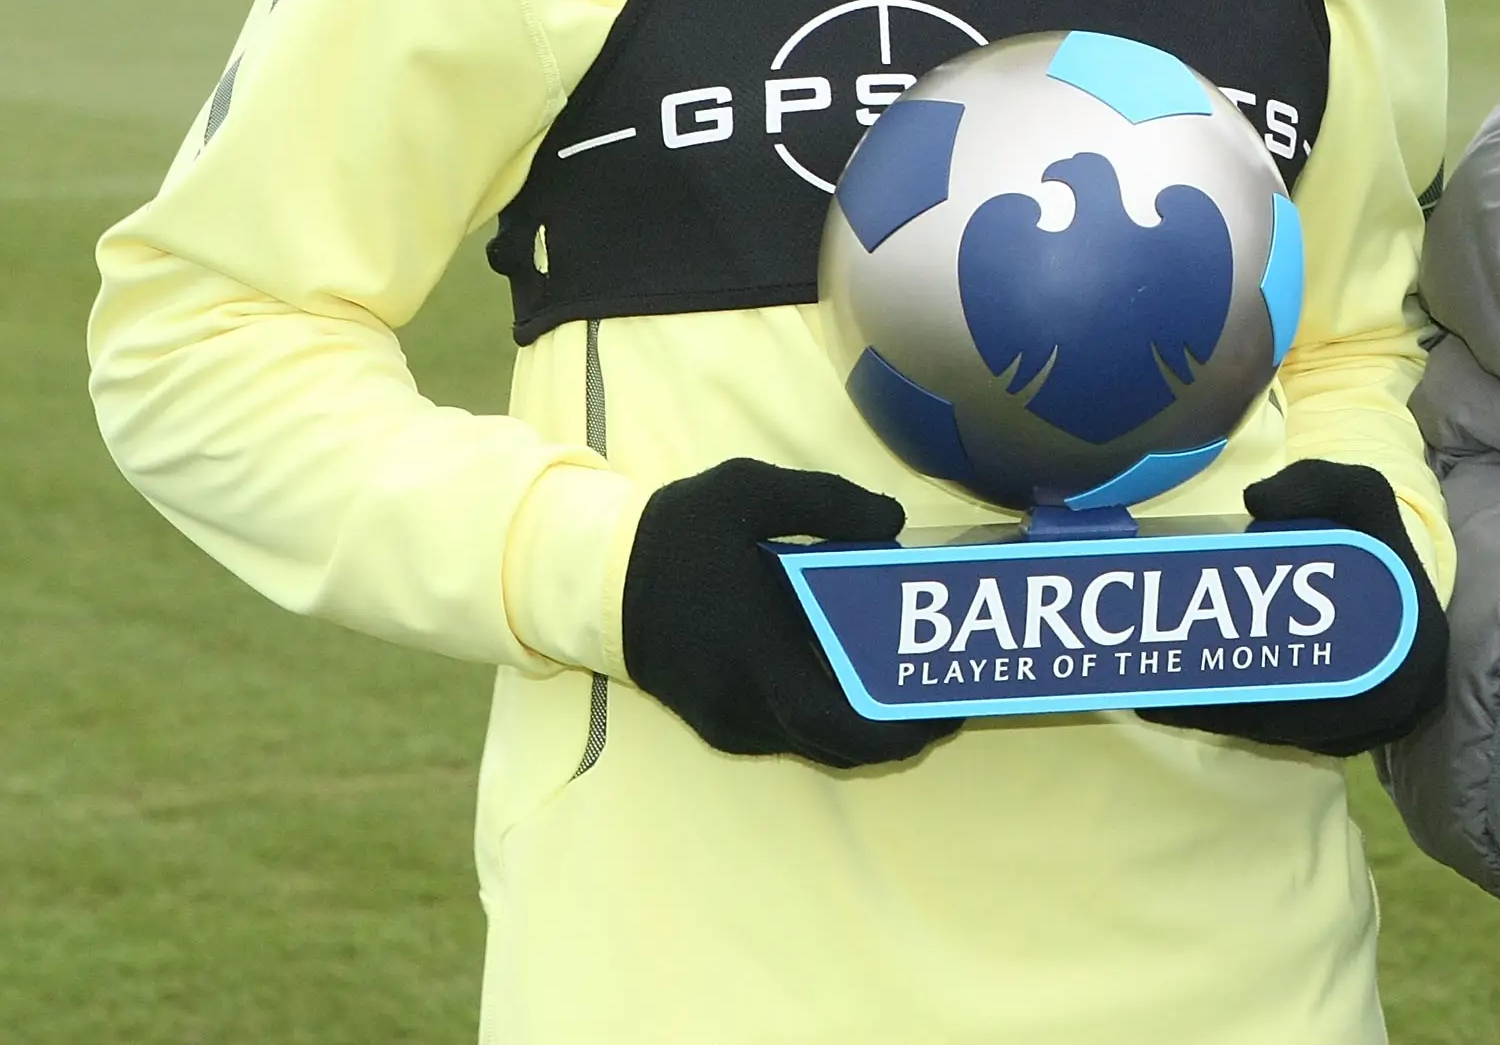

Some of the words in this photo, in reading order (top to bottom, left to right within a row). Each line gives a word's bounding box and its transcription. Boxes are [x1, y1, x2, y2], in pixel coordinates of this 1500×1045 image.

[897, 561, 1337, 655] BARCLAYS
[897, 657, 1037, 687] PLAYER
[1053, 653, 1098, 678] OF
[1114, 649, 1183, 676] THE
[1200, 642, 1332, 672] MONTH
